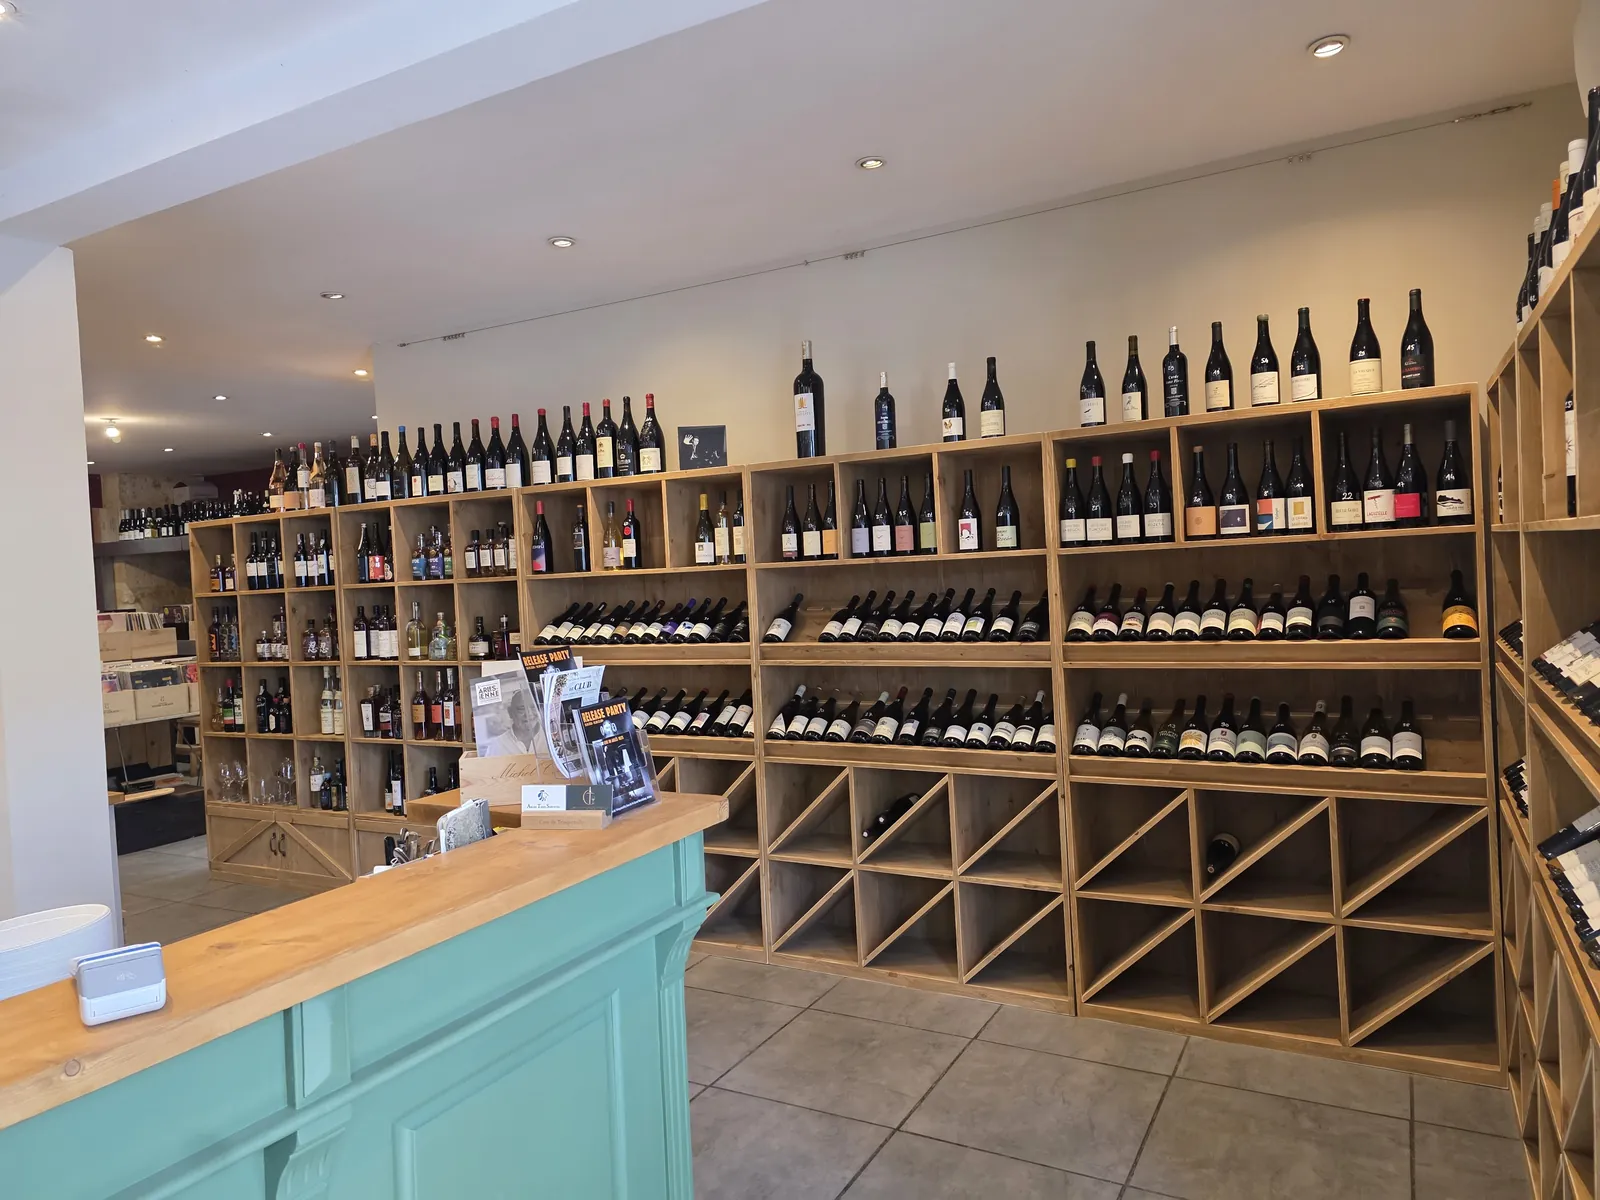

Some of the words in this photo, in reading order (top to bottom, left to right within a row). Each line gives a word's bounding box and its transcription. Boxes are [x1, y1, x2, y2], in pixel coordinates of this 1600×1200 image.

[1342, 492, 1354, 500] 22
[522, 654, 549, 666] RELEASE
[549, 650, 570, 662] PARTY
[574, 681, 592, 690] CLUB
[582, 708, 605, 722] RELEASE
[605, 702, 626, 716] PARTY
